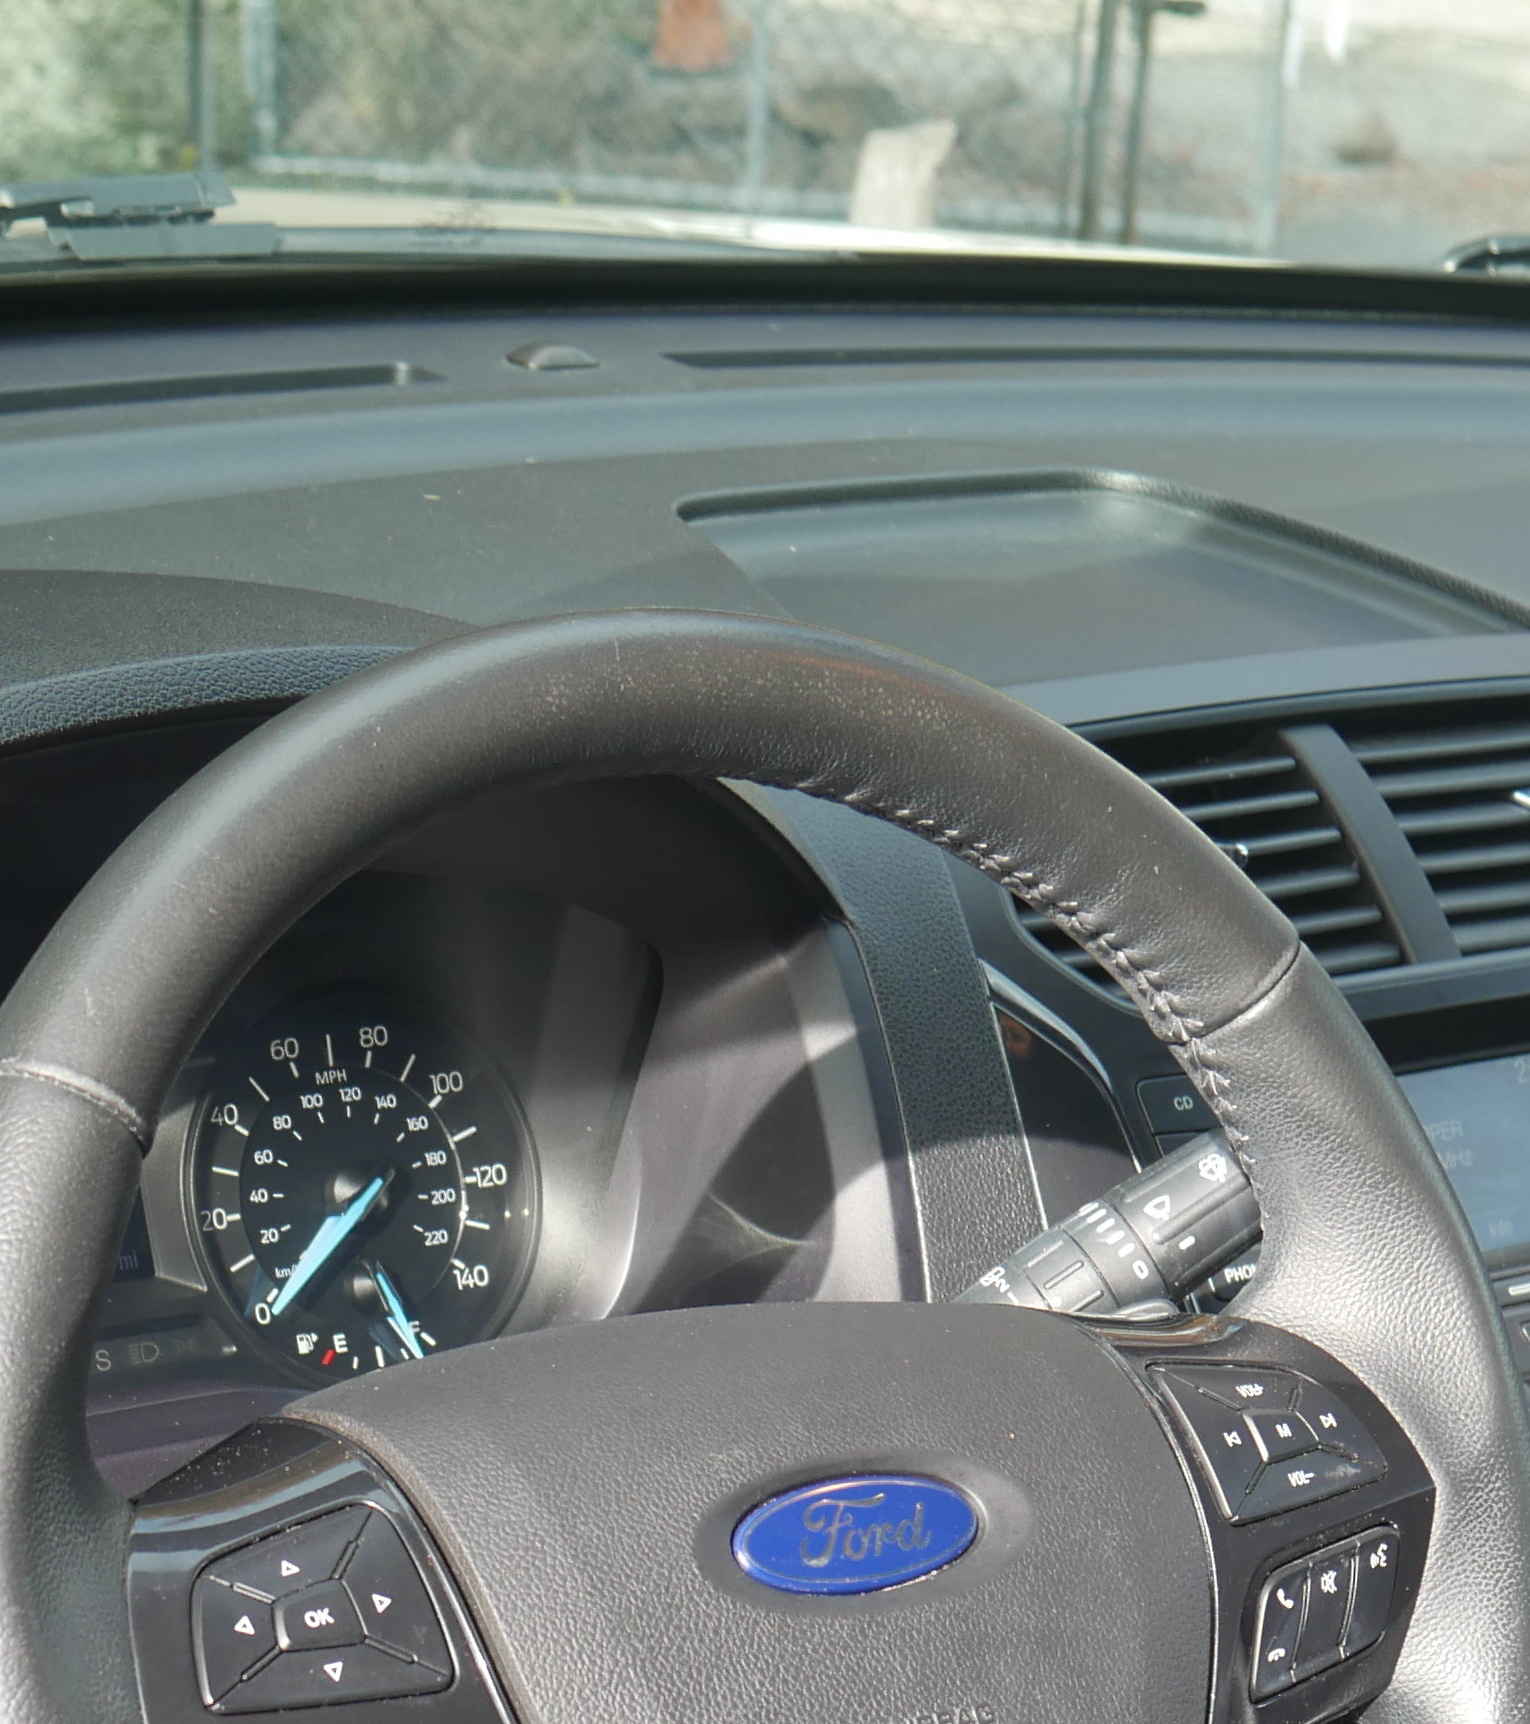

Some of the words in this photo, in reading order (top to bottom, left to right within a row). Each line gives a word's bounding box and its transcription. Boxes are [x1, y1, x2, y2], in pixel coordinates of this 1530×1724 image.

[359, 1026, 388, 1047] 80
[270, 1038, 299, 1061] 60
[315, 1069, 347, 1086] MPH
[429, 1071, 463, 1095] 100
[300, 1093, 323, 1109] 100
[340, 1087, 361, 1102] 120
[375, 1094, 396, 1109] 140
[1173, 1096, 1194, 1111] CD
[211, 1104, 238, 1126] 40
[273, 1115, 292, 1130] 80
[406, 1116, 429, 1132] 160
[254, 1149, 273, 1165] 60
[424, 1150, 447, 1166] 180
[473, 1163, 507, 1188] 120
[250, 1188, 268, 1203] 40
[430, 1188, 456, 1203] 200
[201, 1208, 227, 1232] 20
[261, 1228, 279, 1244] 20
[424, 1229, 448, 1245] 220
[453, 1265, 488, 1289] 140
[255, 1303, 271, 1325] 0
[333, 1333, 349, 1354] E
[95, 1351, 111, 1371] S
[801, 1493, 932, 1567] Ford
[304, 1609, 335, 1629] OK
